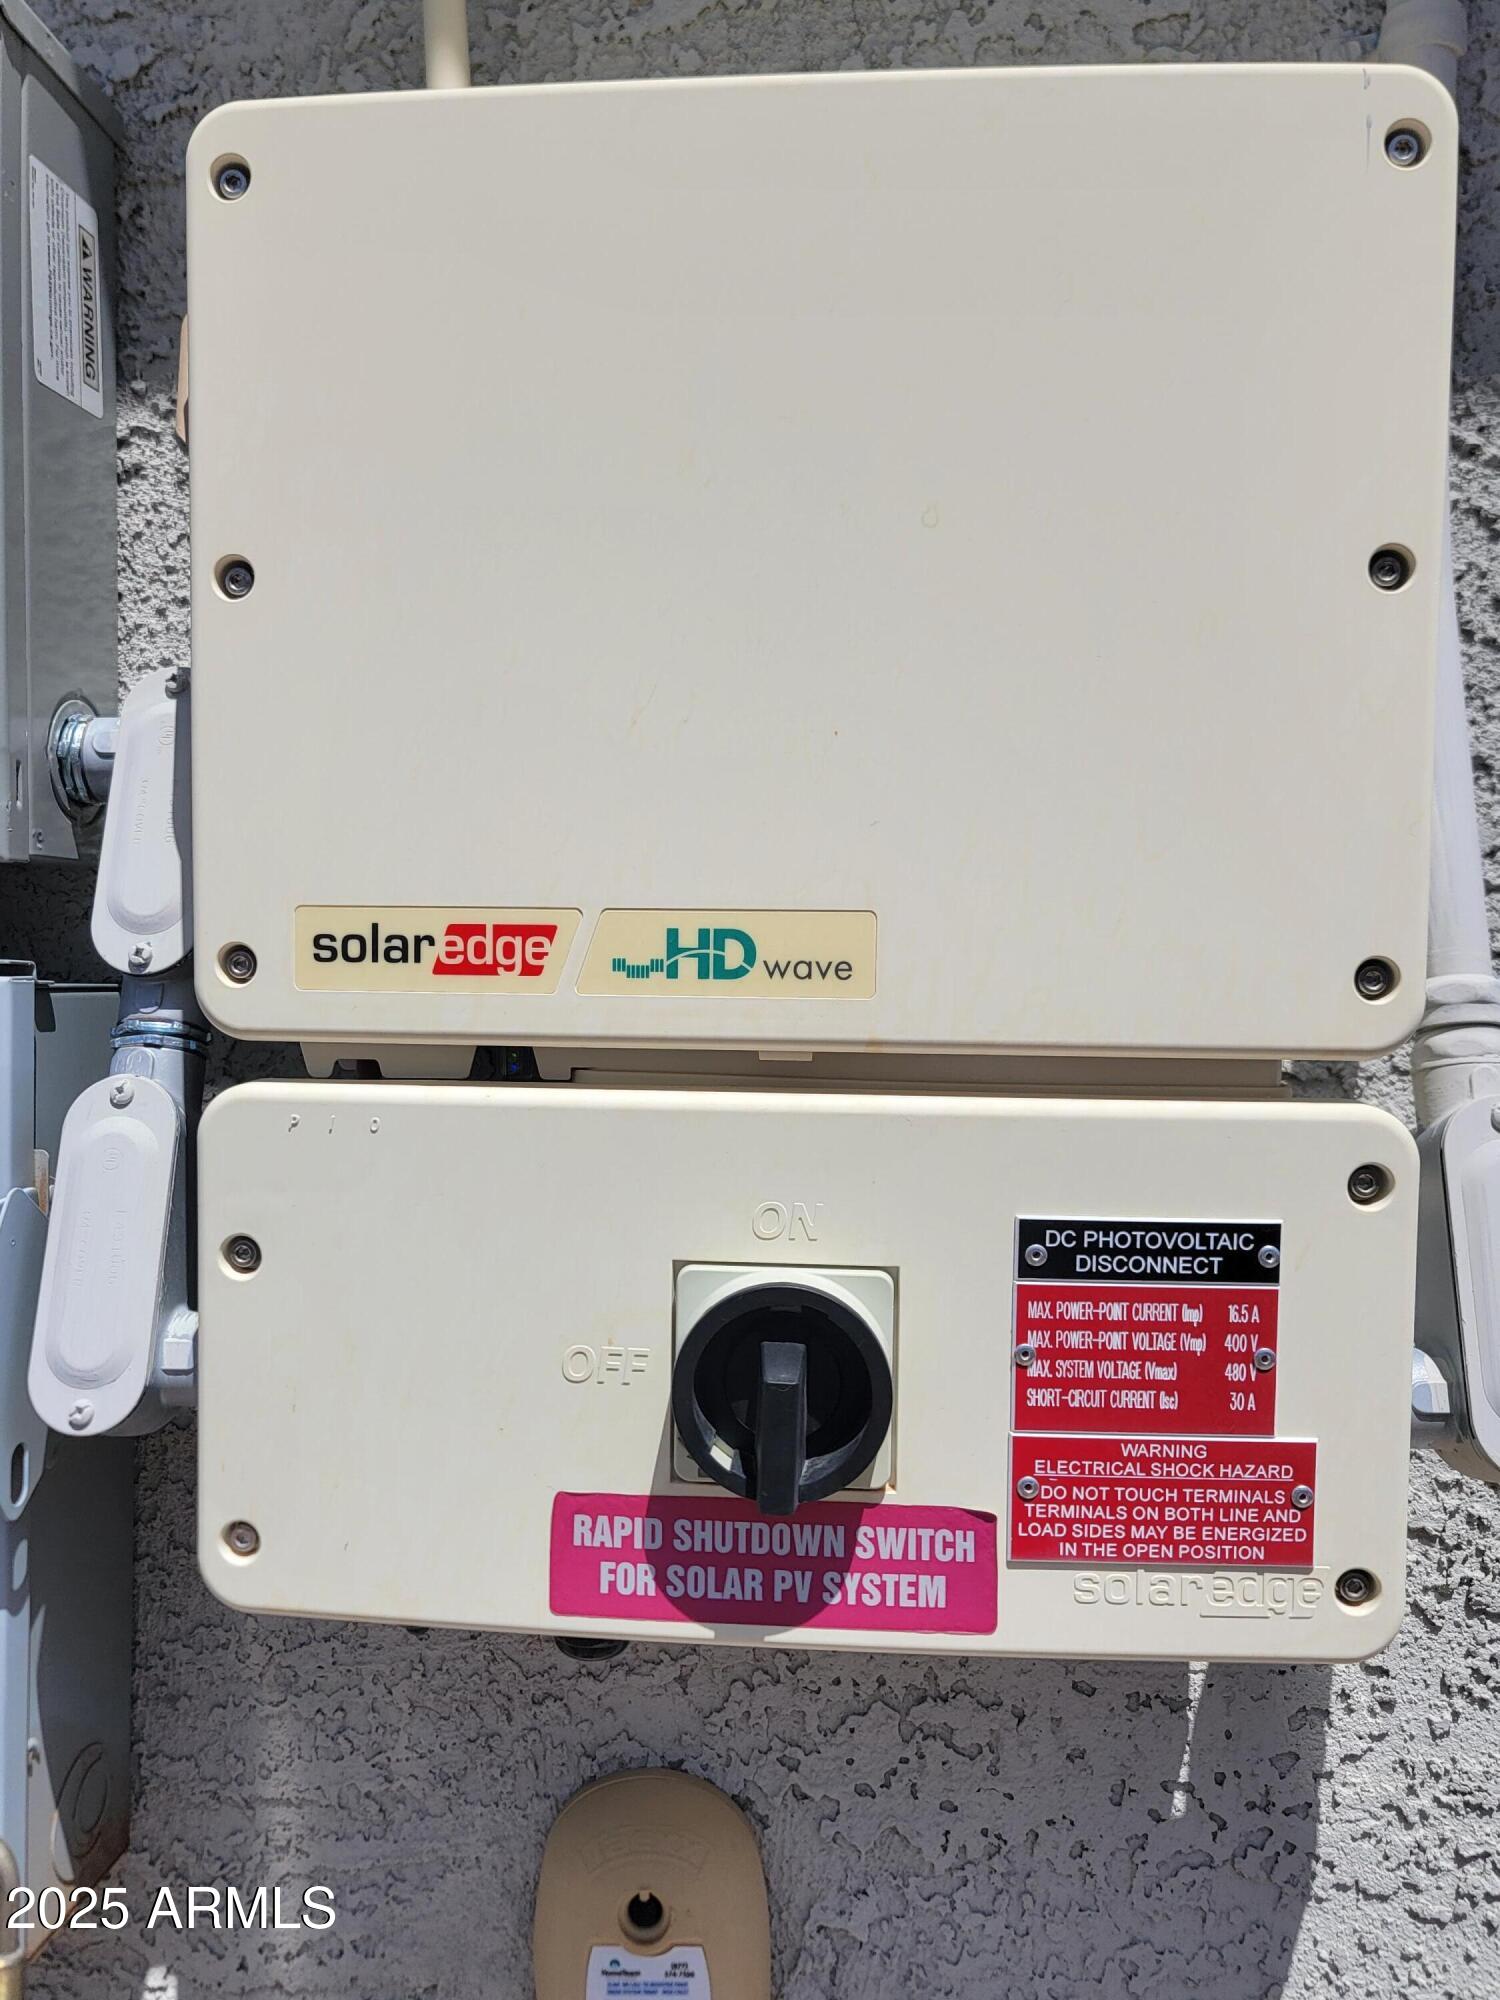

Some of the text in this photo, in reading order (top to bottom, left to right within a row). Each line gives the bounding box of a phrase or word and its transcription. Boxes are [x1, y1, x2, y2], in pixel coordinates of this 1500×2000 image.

[81, 267, 96, 380] WARNING
[312, 923, 552, 975] solaredge
[666, 928, 853, 981] HD wave
[752, 1201, 824, 1241] ON
[1045, 1229, 1254, 1250] DC PHOTOVOLTAIC
[1076, 1255, 1223, 1274] DISCONNECT
[1028, 1301, 1053, 1320] MAX.
[1056, 1302, 1129, 1321] POWER-POINT
[1133, 1303, 1178, 1322] CURRENT
[1228, 1305, 1249, 1323] 16.5
[1251, 1305, 1259, 1323] A
[1028, 1330, 1053, 1349] MAX.
[1056, 1331, 1129, 1350] POWER-POINT
[1132, 1332, 1176, 1351] VOLTAGE
[1224, 1334, 1247, 1352] 400
[1250, 1334, 1258, 1351] V
[562, 1345, 650, 1385] OFF
[1027, 1360, 1257, 1382] MAX. SYSTEM VOLTAGE (Vmax) 480 V
[1027, 1388, 1106, 1408] SHORT-CIRCUIT
[1110, 1390, 1155, 1409] CURRENT
[1230, 1392, 1244, 1411] 30
[1248, 1393, 1256, 1411] A
[1121, 1443, 1207, 1458] WARNING
[1035, 1460, 1293, 1479] ELECTRICAL SHOCK HAZARD
[1041, 1486, 1286, 1504] DO NOT TOUCH TERMINALS
[1024, 1503, 1301, 1523] TERMINALS ON BOTH LINE AND
[573, 1514, 975, 1562] RAPID SHUTDOWN SWITCH
[1018, 1523, 1307, 1542] LOAD SIDES MAY BE ENERGIZED
[1059, 1542, 1265, 1560] IN THE OPEN POSITION
[600, 1561, 946, 1608] FOR SOLAR PV SYSTEM
[1073, 1569, 1324, 1615] solaredge
